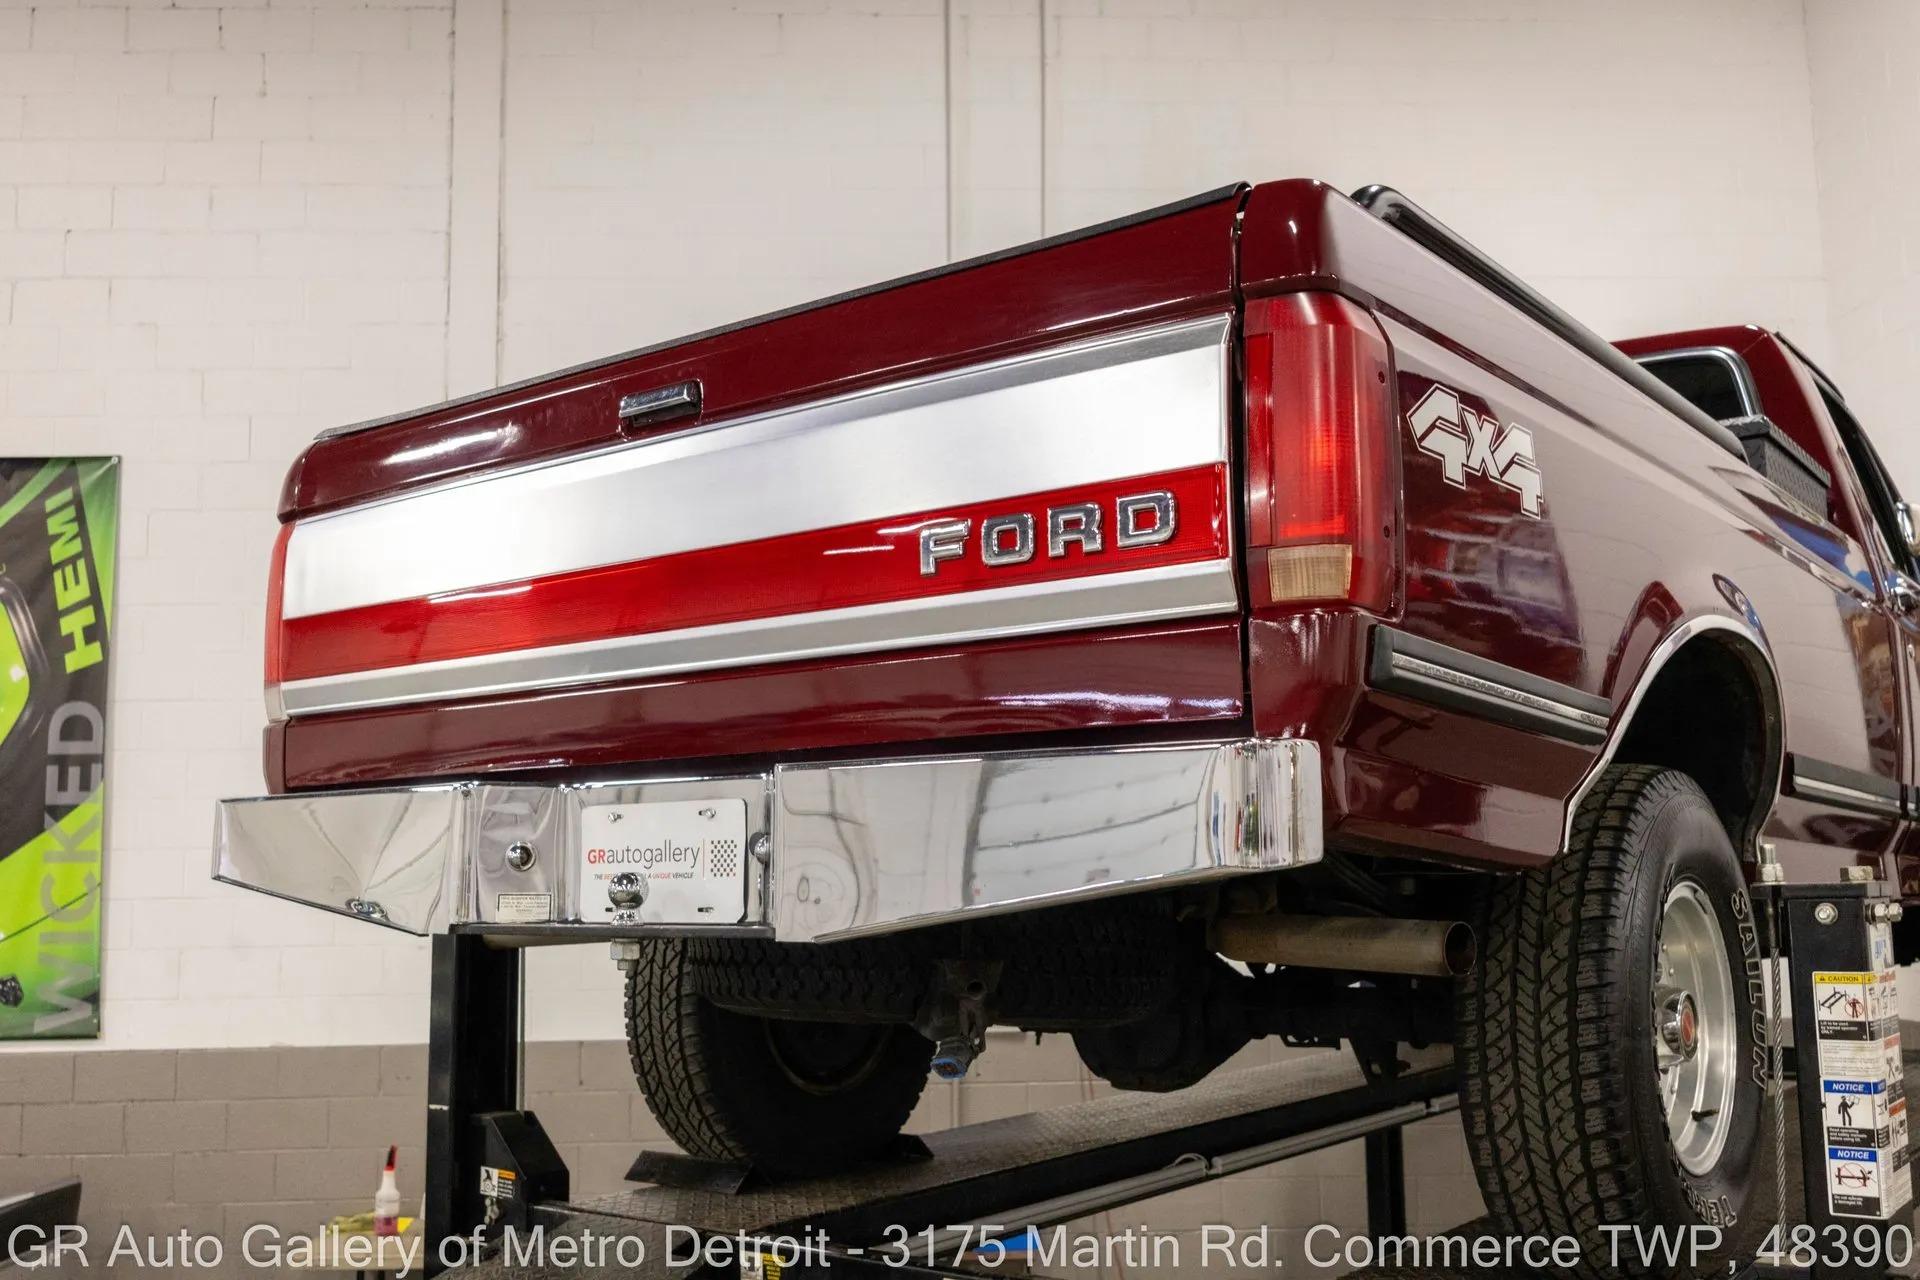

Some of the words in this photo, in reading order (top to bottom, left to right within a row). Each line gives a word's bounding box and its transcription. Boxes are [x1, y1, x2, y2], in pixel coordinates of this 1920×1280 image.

[44, 486, 104, 674] HEMI
[919, 489, 1176, 576] FORD
[33, 700, 105, 1034] WICKED
[1731, 887, 1768, 1089] SAILUN
[1832, 1082, 1865, 1091] NOTICE
[1837, 1149, 1870, 1159] NOTICE
